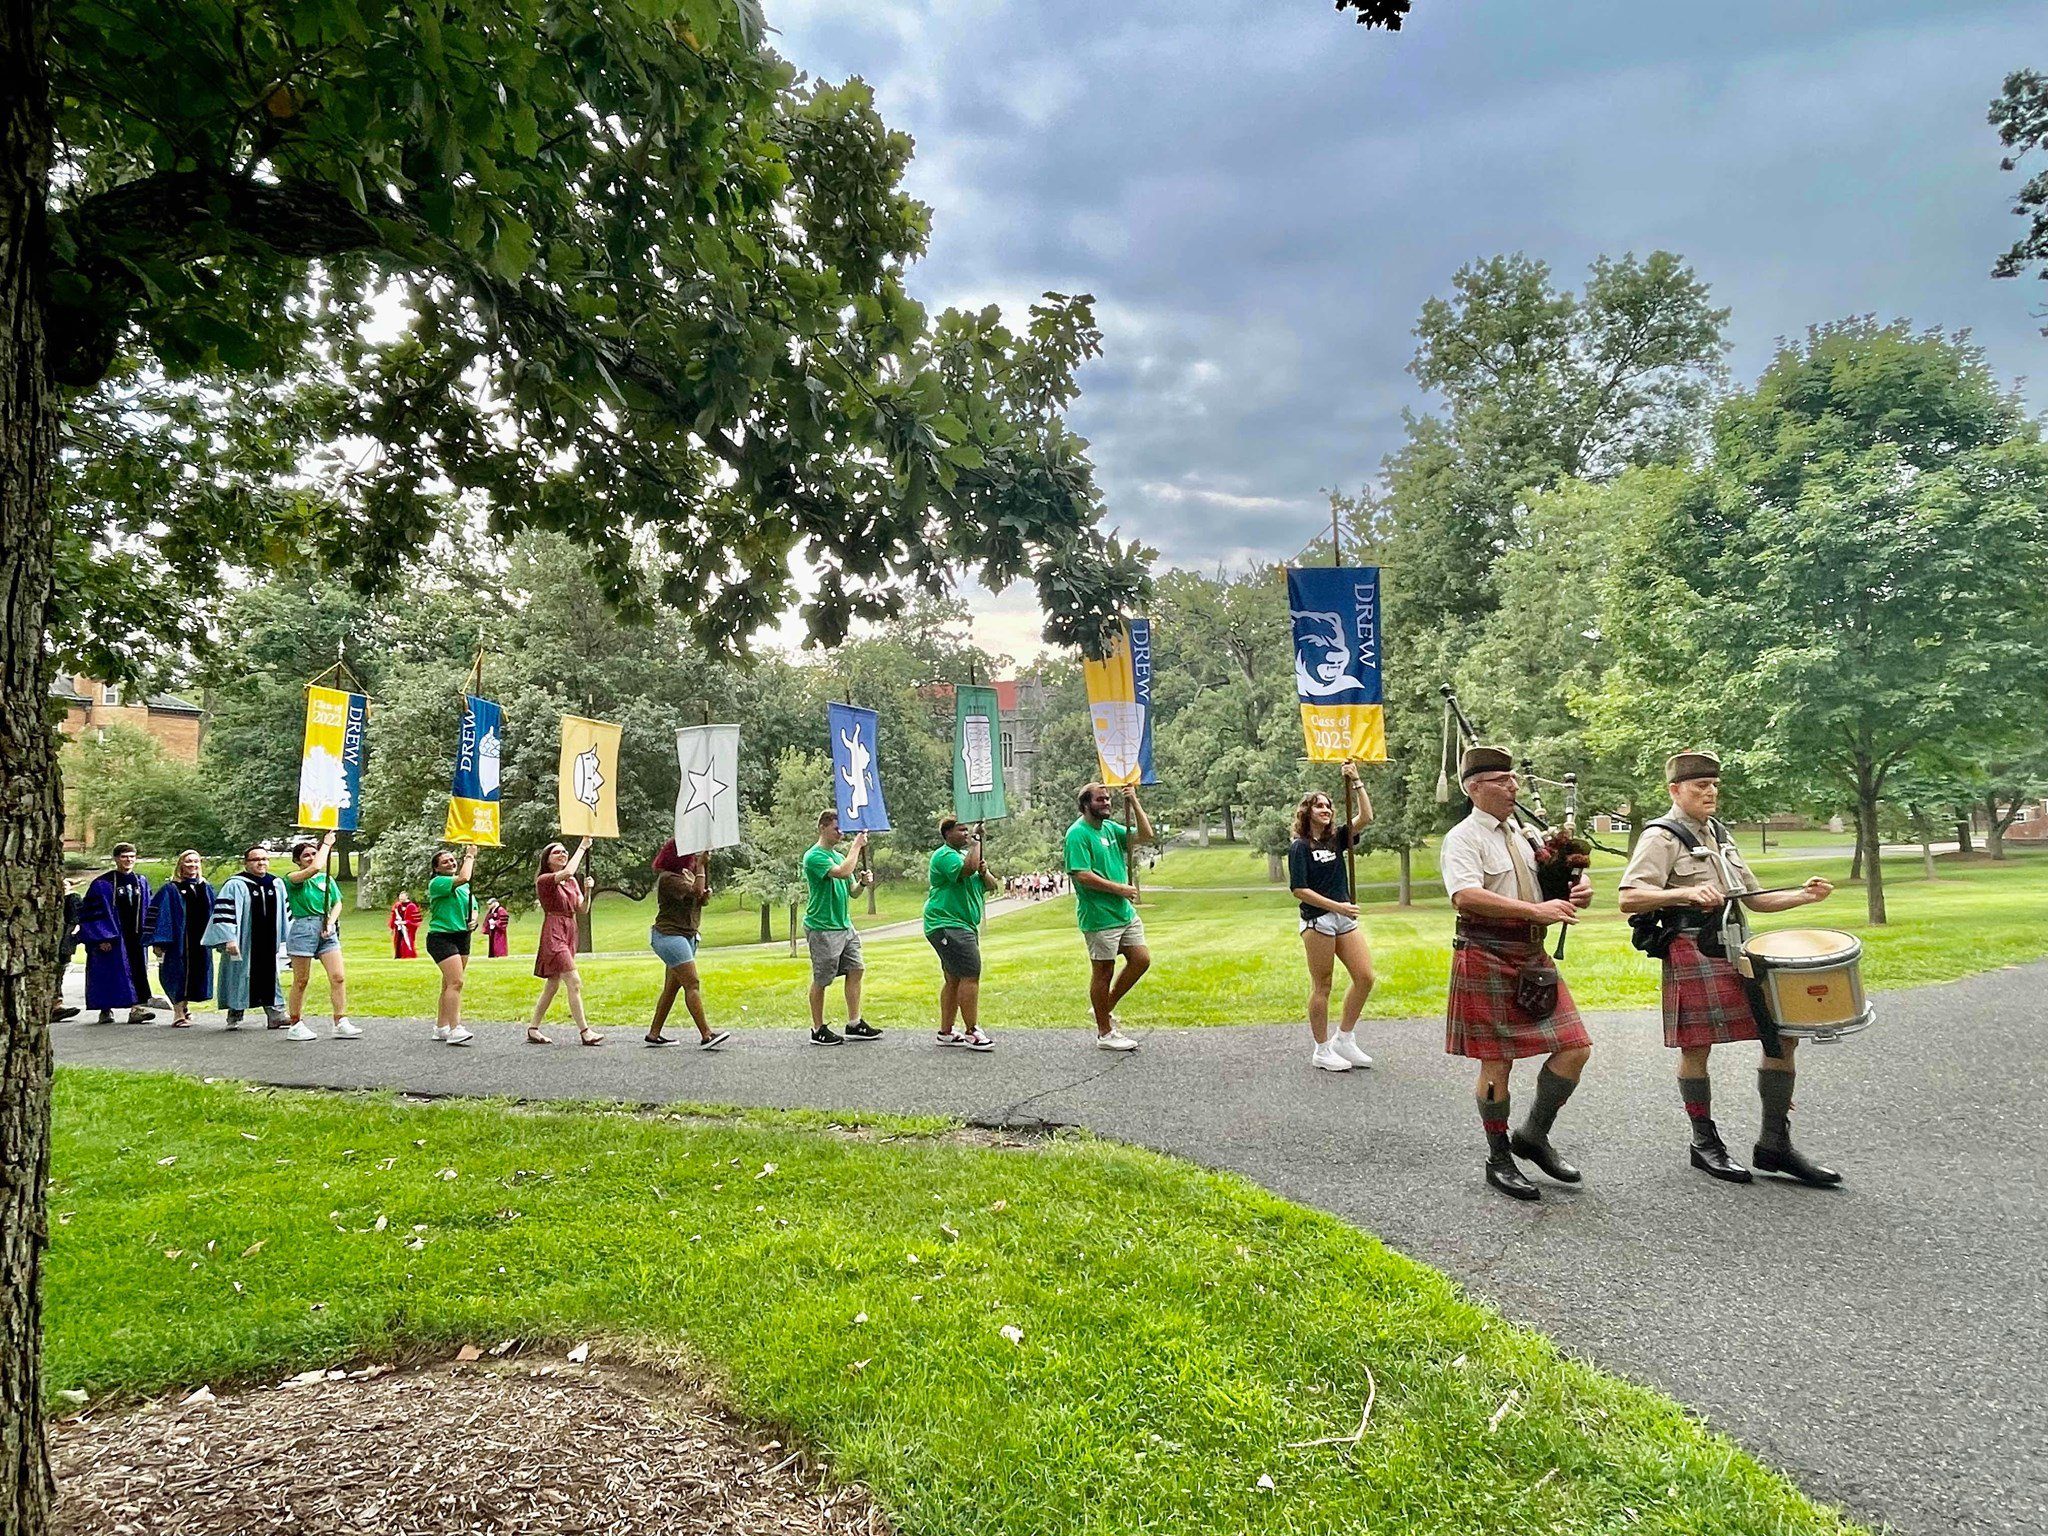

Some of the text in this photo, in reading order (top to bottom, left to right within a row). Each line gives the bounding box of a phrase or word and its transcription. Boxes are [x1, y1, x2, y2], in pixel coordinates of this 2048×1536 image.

[1354, 583, 1376, 669] DREW
[1132, 628, 1151, 701] DREW
[344, 706, 363, 766] DREW
[460, 709, 476, 772] DREW
[1315, 730, 1352, 749] 2025
[1338, 714, 1351, 729] of
